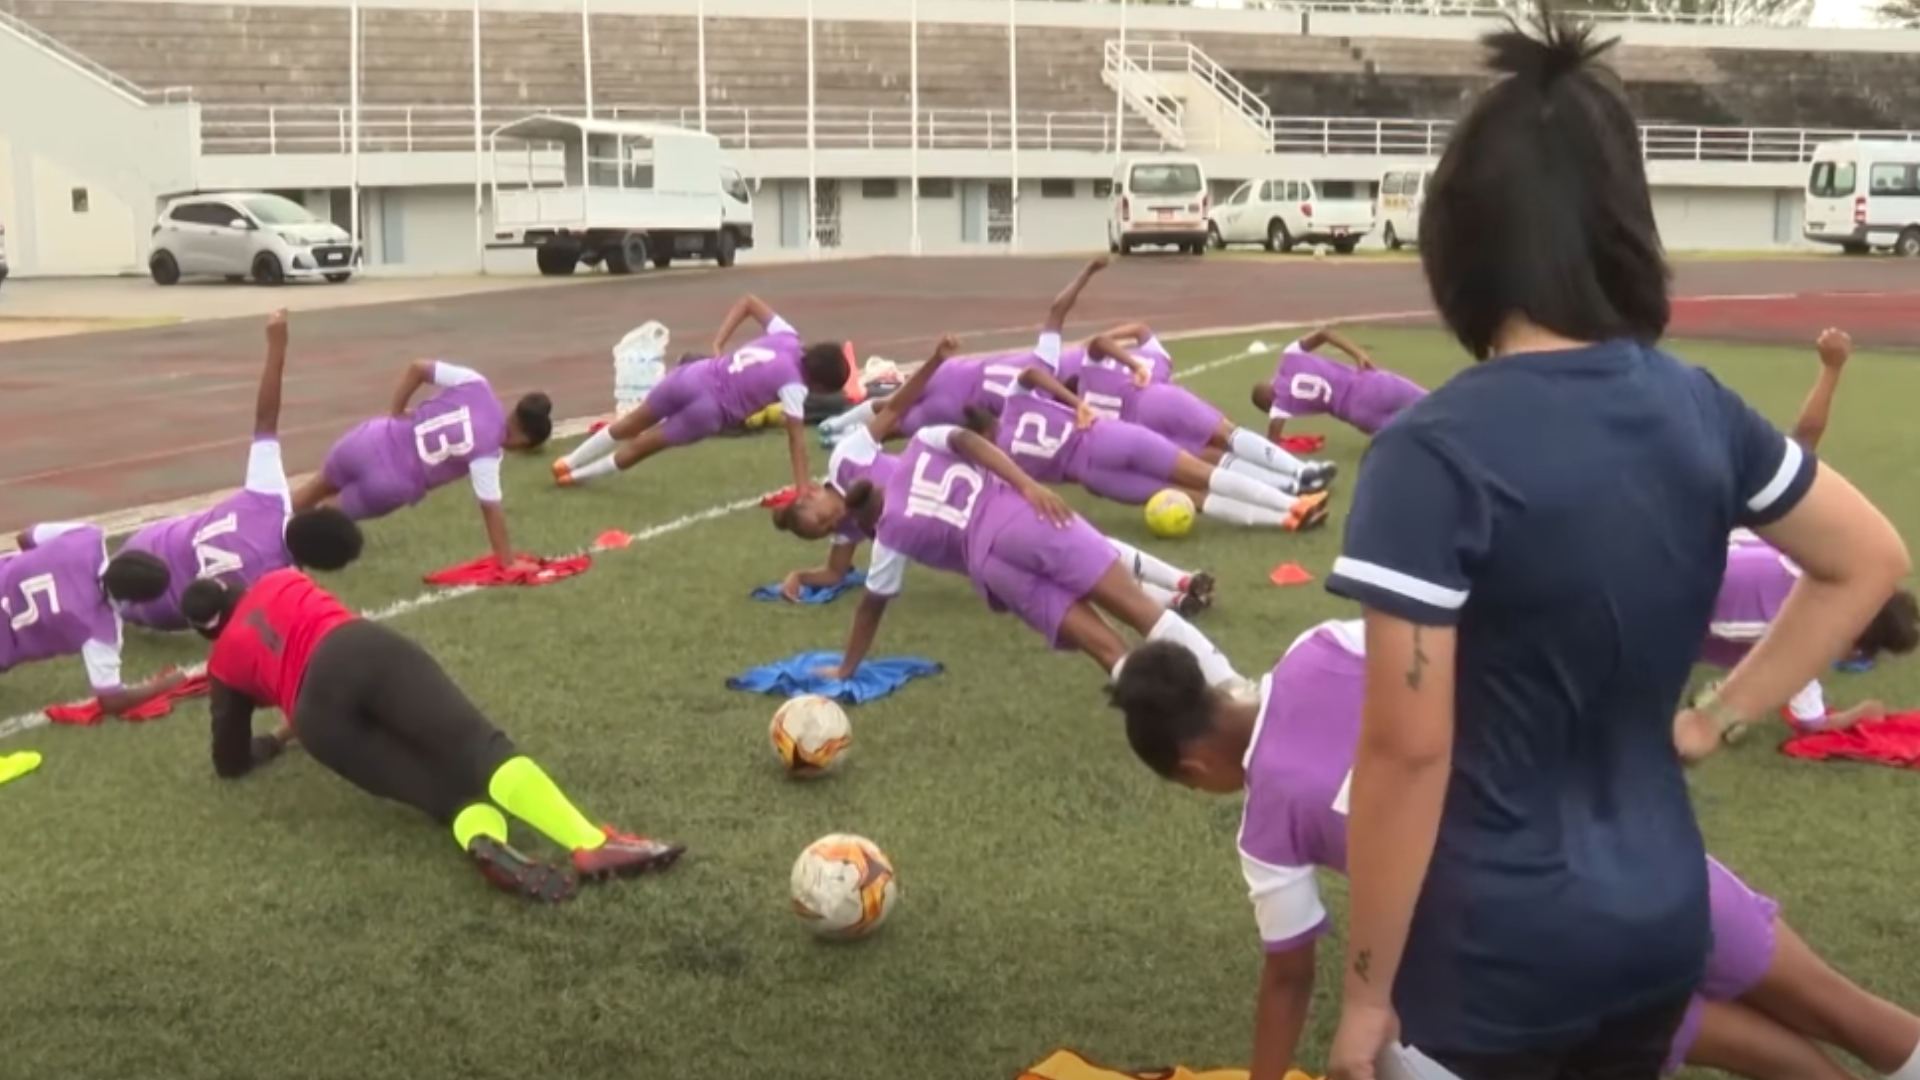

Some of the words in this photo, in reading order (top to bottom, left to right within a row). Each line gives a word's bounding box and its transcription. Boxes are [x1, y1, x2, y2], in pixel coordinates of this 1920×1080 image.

[727, 346, 776, 374] 4
[1291, 373, 1332, 403] 9
[414, 405, 474, 466] 13
[1011, 412, 1073, 459] 12
[904, 451, 983, 530] 15
[192, 512, 243, 578] 14
[11, 573, 60, 631] 5
